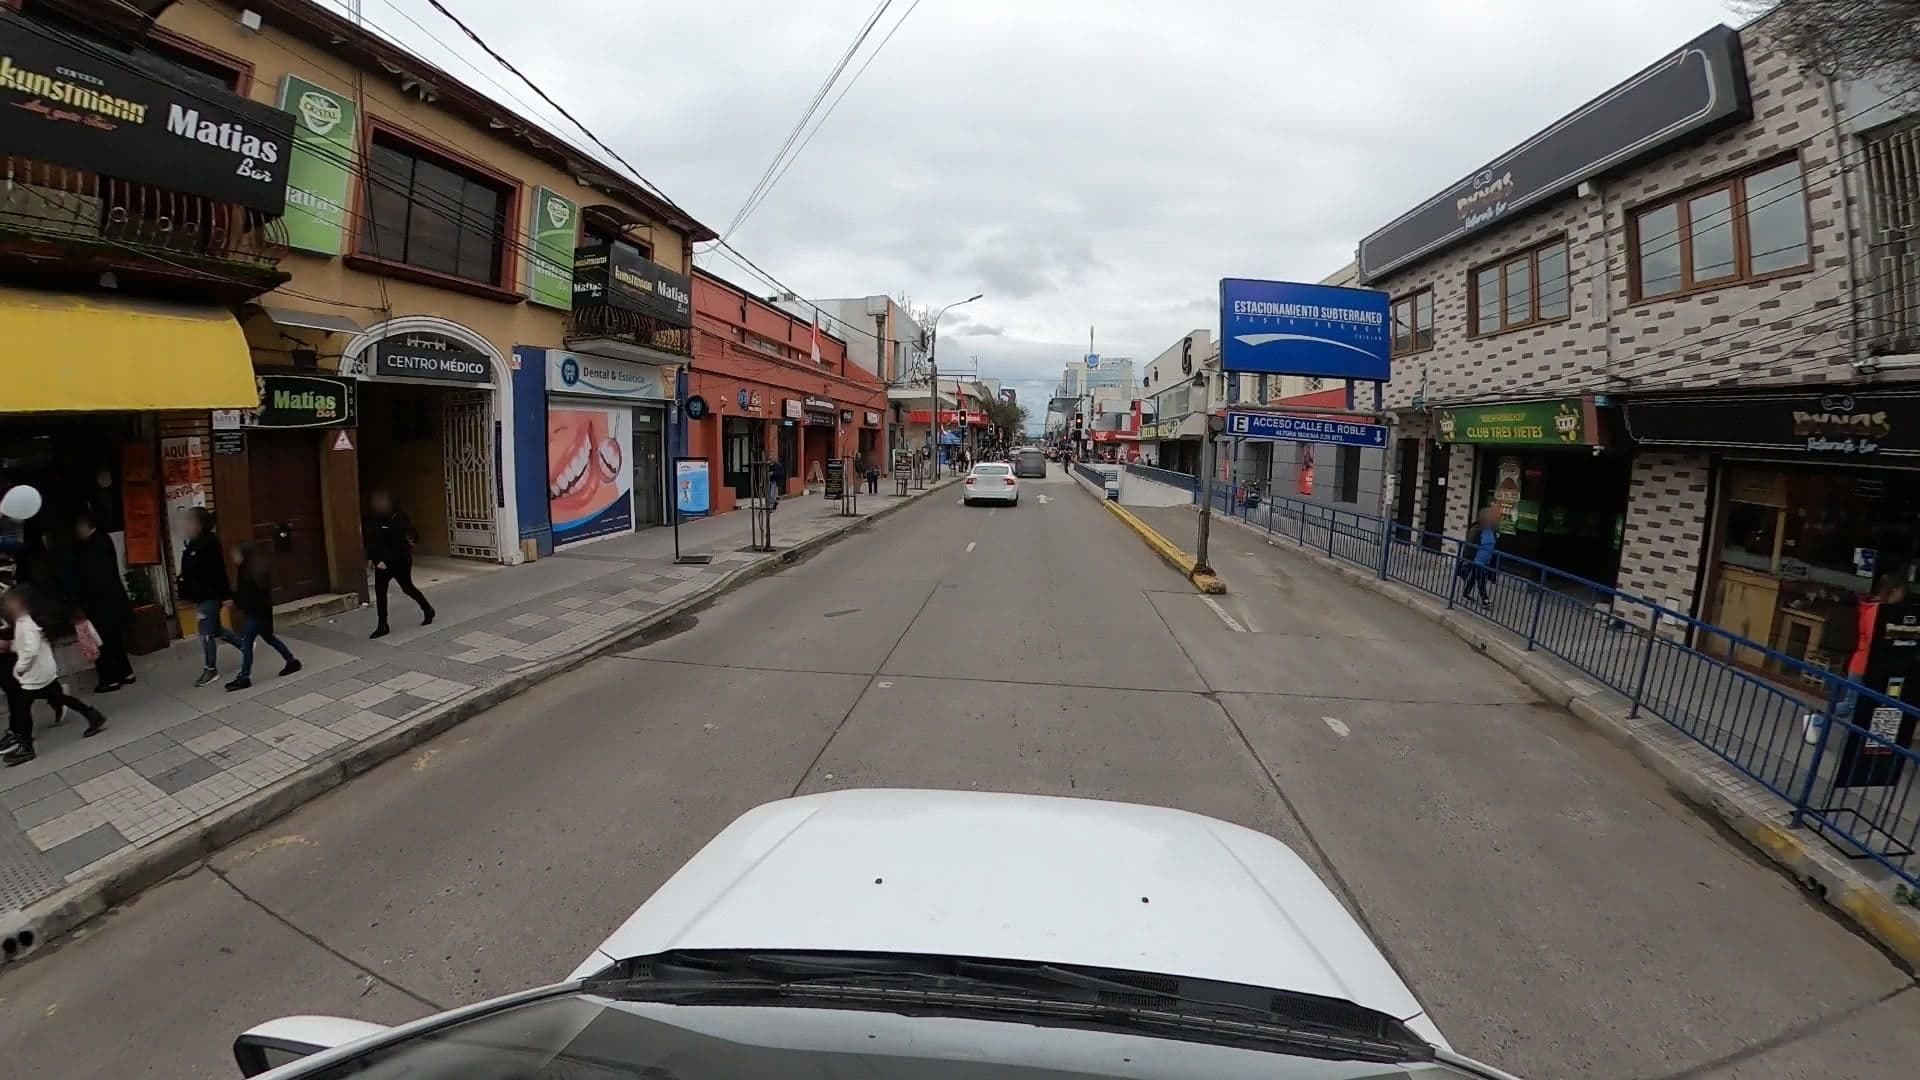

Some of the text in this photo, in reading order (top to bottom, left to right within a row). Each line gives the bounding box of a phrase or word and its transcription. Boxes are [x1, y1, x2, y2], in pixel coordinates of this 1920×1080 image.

[167, 103, 278, 163] Matias
[236, 157, 273, 183] Bar
[657, 280, 689, 304] Matias
[1234, 300, 1382, 324] ESTACIONAMIENTO SUBTERRANEO
[388, 354, 485, 375] CENTRO MÉDICO
[583, 367, 610, 380] Dental
[1236, 416, 1366, 436] E ACCESO CALLE EL ROBLE
[1466, 426, 1489, 438] CLUB
[1491, 426, 1511, 438] TRES
